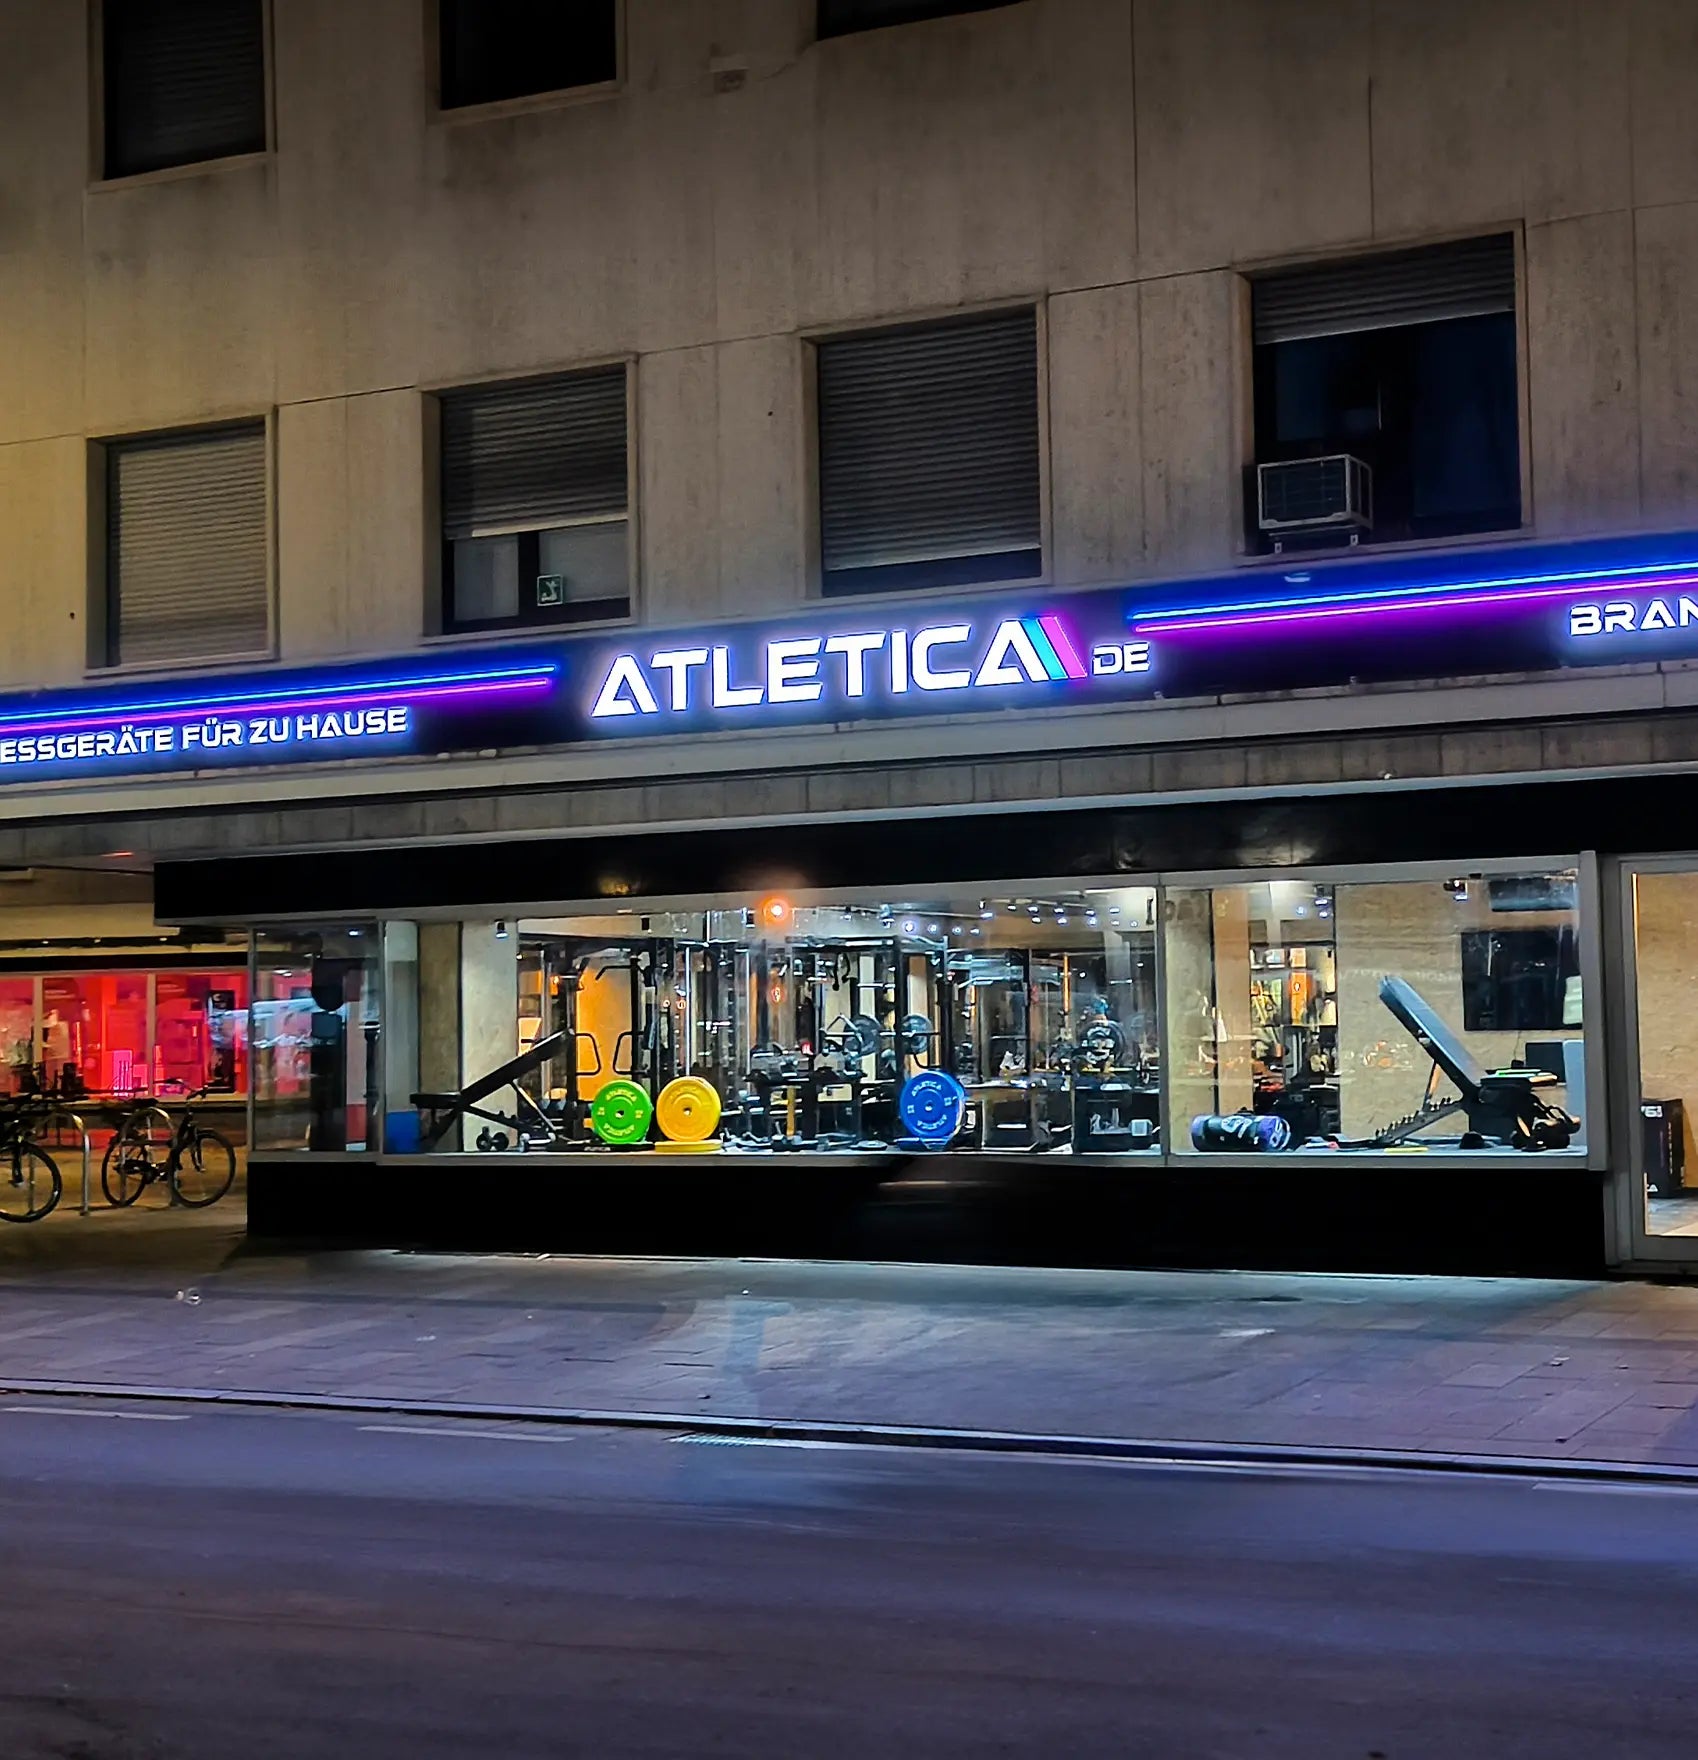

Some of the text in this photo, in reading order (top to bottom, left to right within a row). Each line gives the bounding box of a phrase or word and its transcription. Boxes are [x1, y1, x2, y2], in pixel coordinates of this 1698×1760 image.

[590, 618, 1150, 717] ATLETICA DE
[0, 707, 408, 763] ESSGERÄTE FÜR ZU HAUSE
